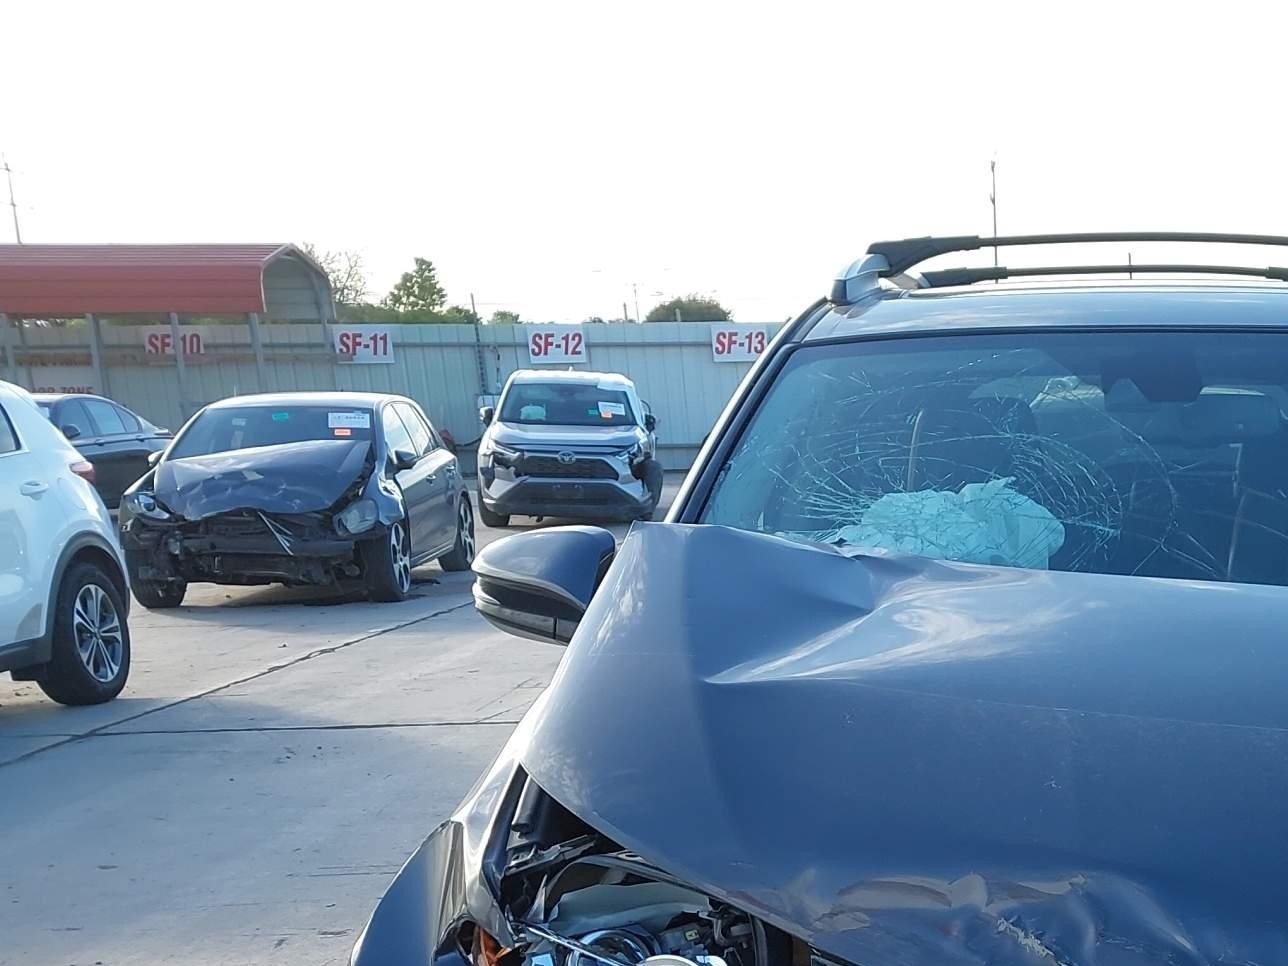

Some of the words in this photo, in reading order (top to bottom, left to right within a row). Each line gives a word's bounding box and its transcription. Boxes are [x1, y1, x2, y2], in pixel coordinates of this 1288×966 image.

[147, 332, 201, 355] SF10
[338, 332, 388, 356] SF-11
[530, 331, 583, 356] SF-12
[714, 331, 765, 355] SF-13
